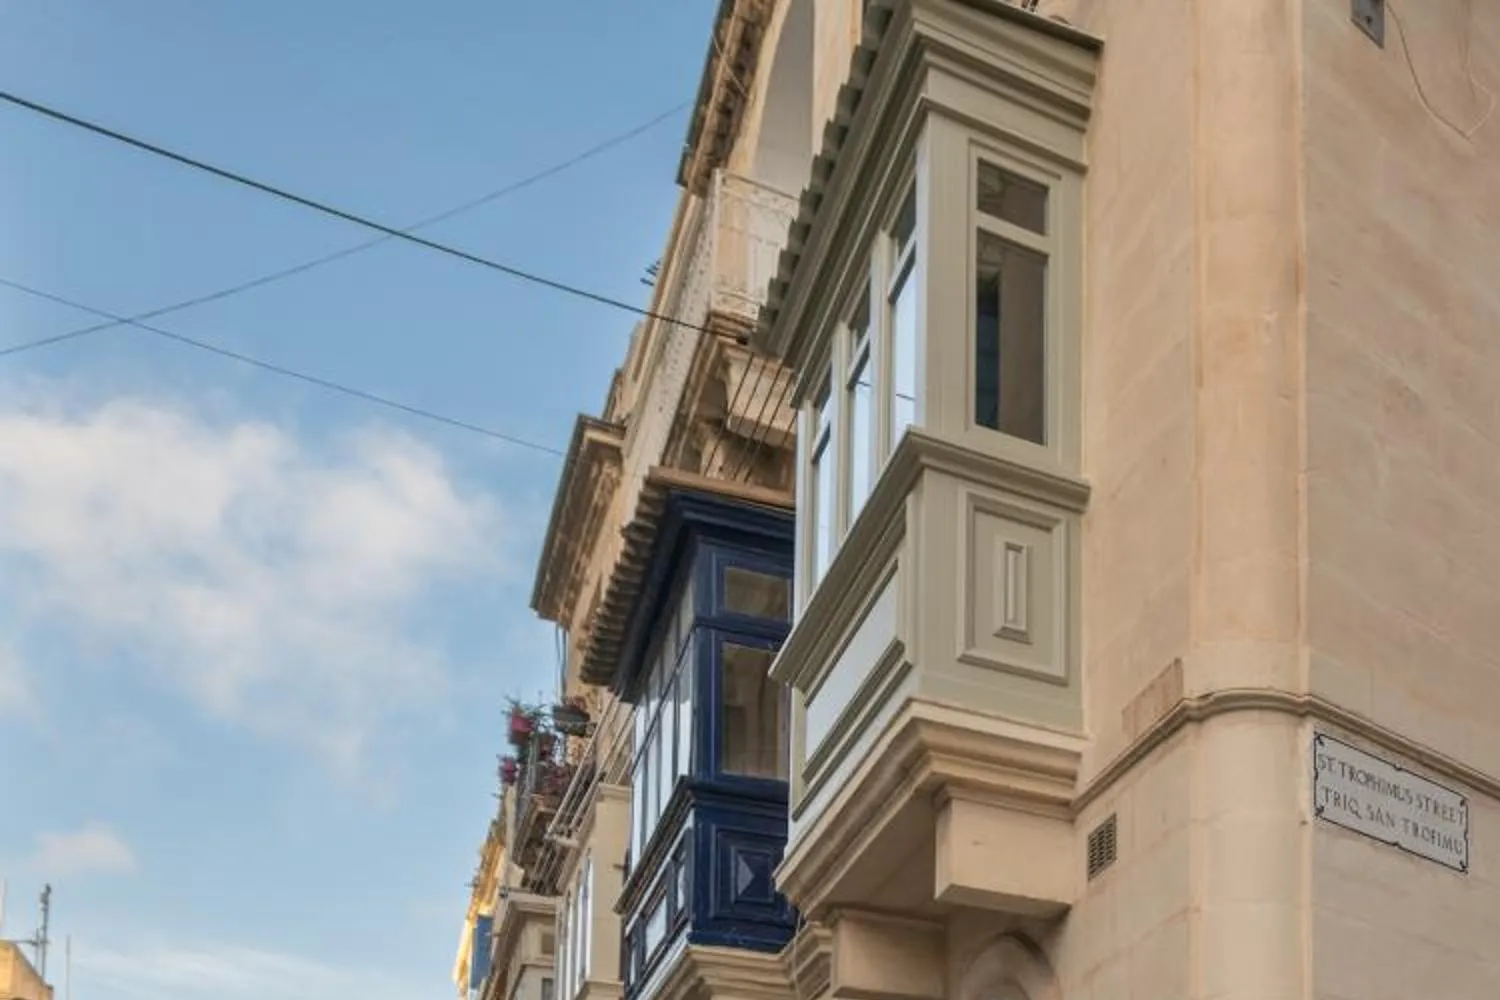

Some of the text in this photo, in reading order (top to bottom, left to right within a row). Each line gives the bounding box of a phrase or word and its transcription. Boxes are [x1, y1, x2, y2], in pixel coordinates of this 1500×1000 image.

[1321, 786, 1363, 820] TRIQ
[1366, 803, 1395, 828] SAN
[1416, 793, 1464, 826] STREET
